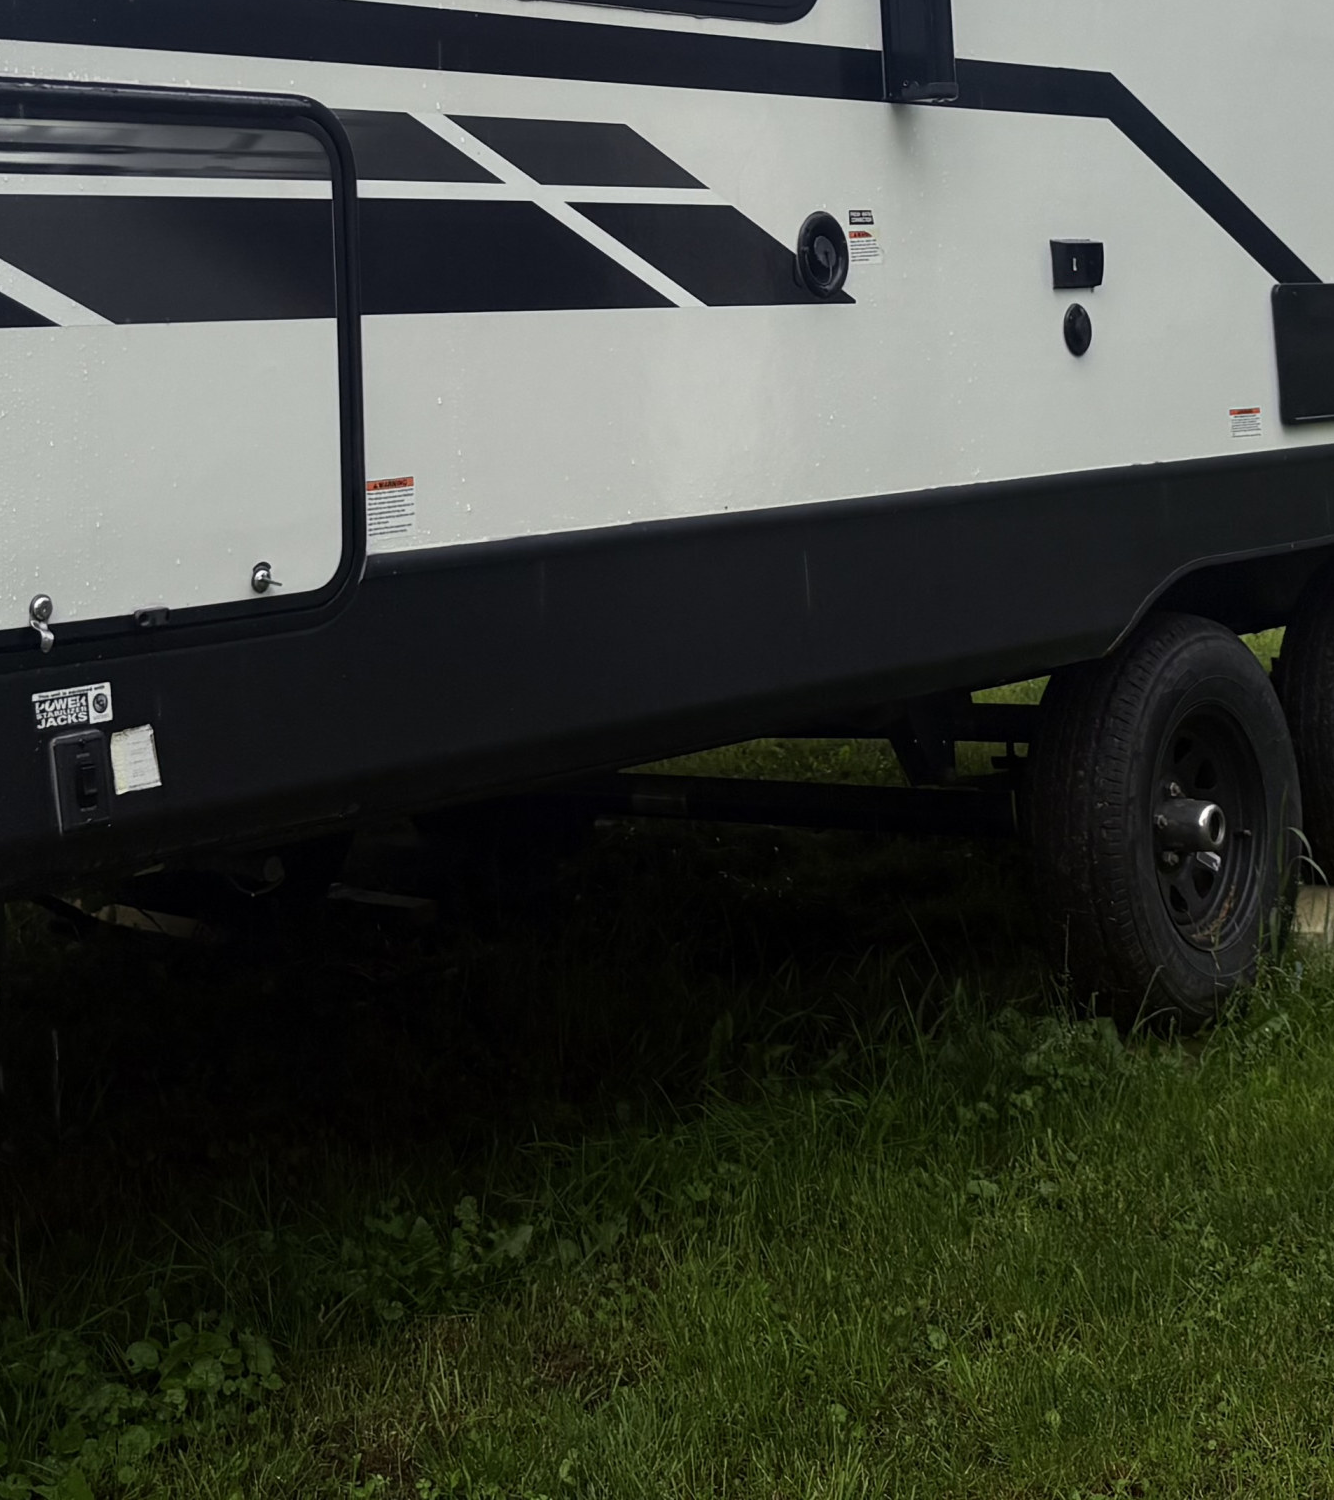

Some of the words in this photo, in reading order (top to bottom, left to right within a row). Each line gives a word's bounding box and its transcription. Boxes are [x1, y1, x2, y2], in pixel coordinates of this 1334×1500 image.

[35, 696, 87, 713] POWER
[36, 706, 87, 720] STABILIZER
[37, 712, 88, 729] JACKS
